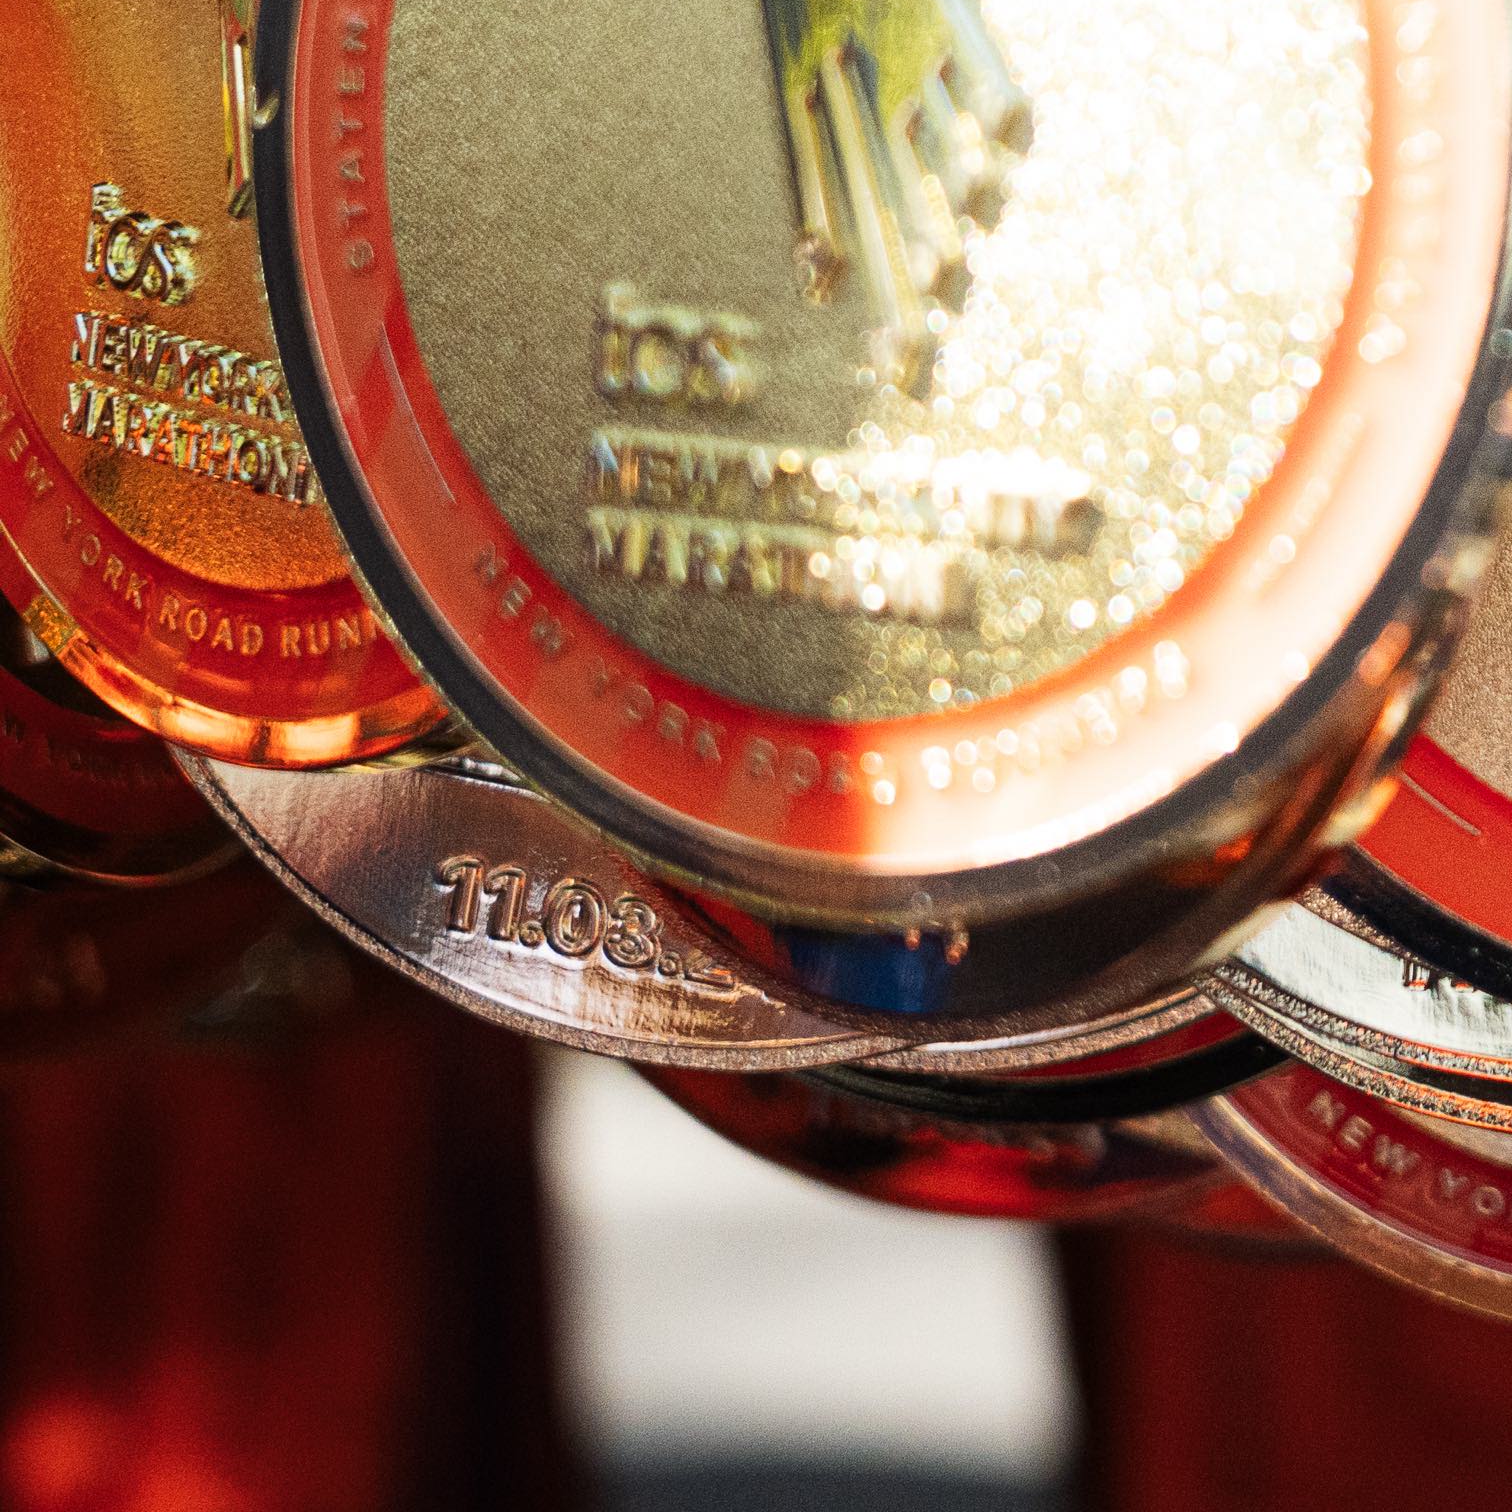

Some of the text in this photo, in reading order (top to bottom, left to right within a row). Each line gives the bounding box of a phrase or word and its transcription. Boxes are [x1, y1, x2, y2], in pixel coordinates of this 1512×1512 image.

[61, 504, 150, 610] YORK
[158, 593, 264, 657] ROAD
[1305, 1086, 1420, 1184] NEW
